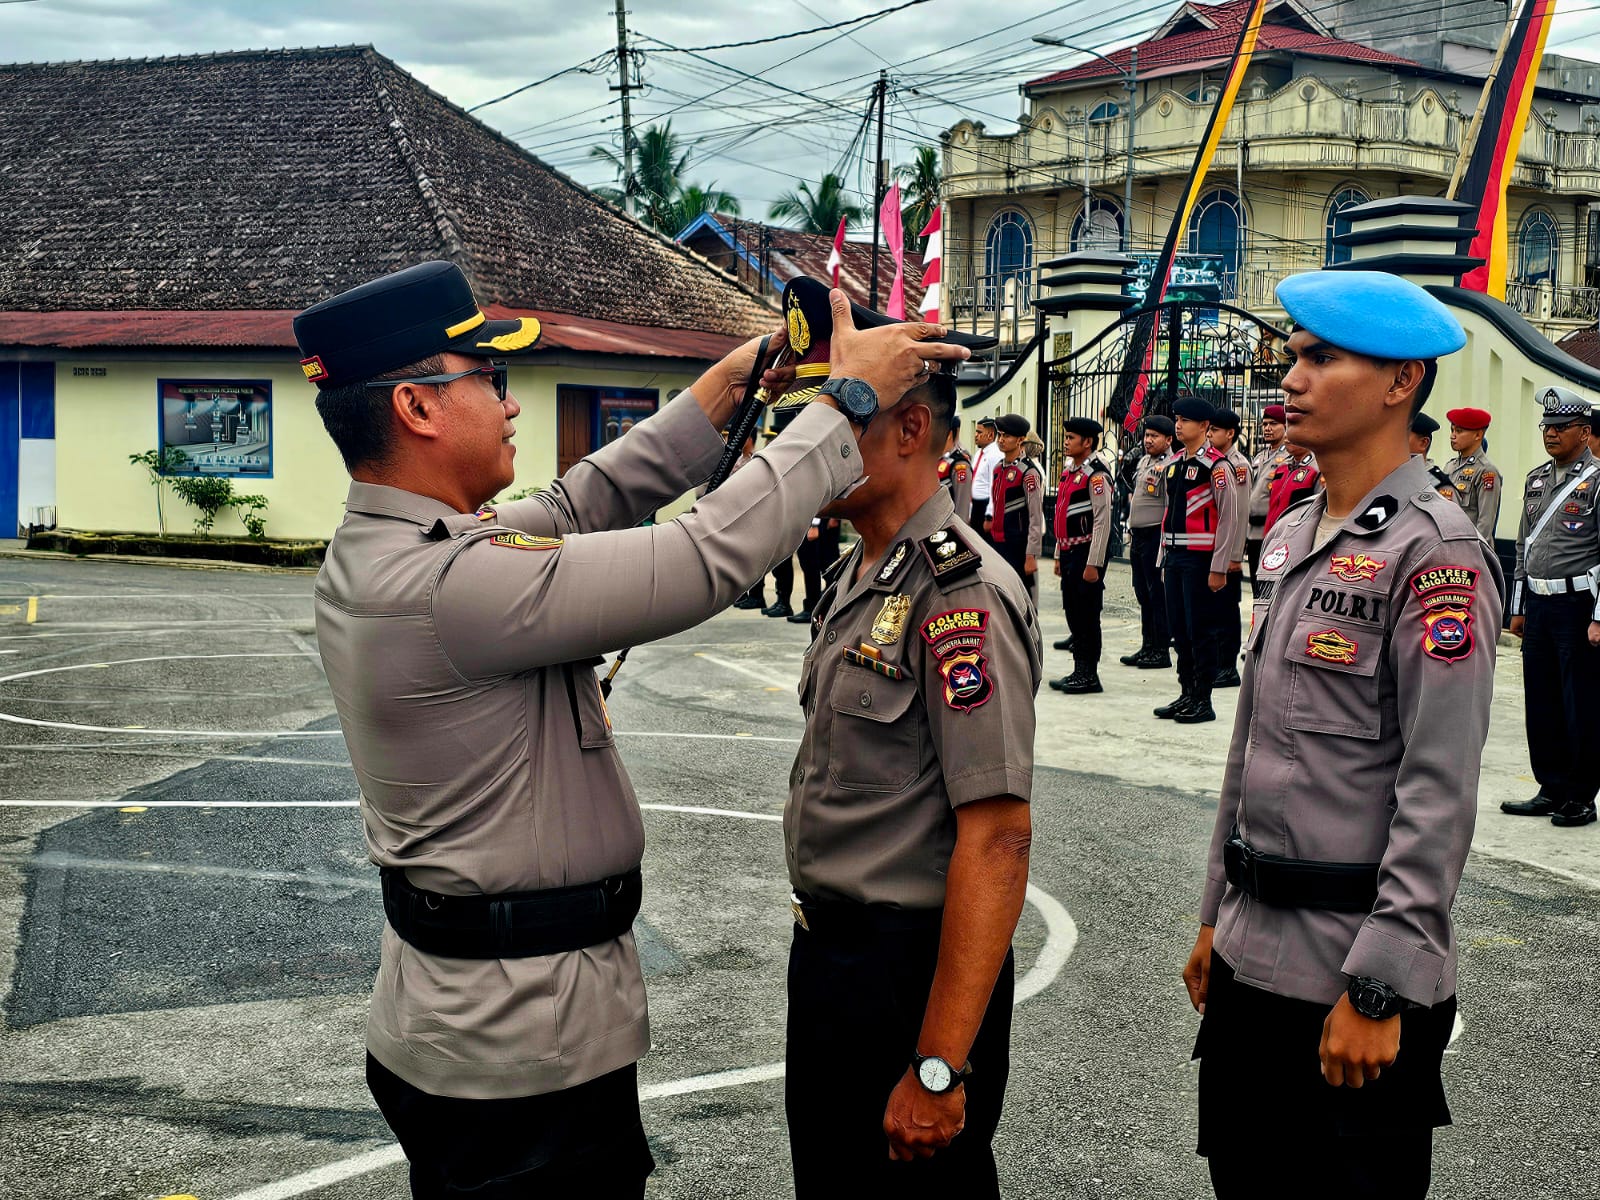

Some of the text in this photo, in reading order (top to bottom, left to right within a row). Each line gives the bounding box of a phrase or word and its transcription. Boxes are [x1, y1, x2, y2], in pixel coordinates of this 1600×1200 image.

[1418, 576, 1471, 591] SOLOK KOTA
[1420, 569, 1468, 584] POLRES
[1305, 587, 1383, 622] POLRI
[1425, 595, 1470, 606] SUMATERA BARAT
[928, 611, 979, 632] POLRES
[929, 619, 980, 639] SOLOK KOTA
